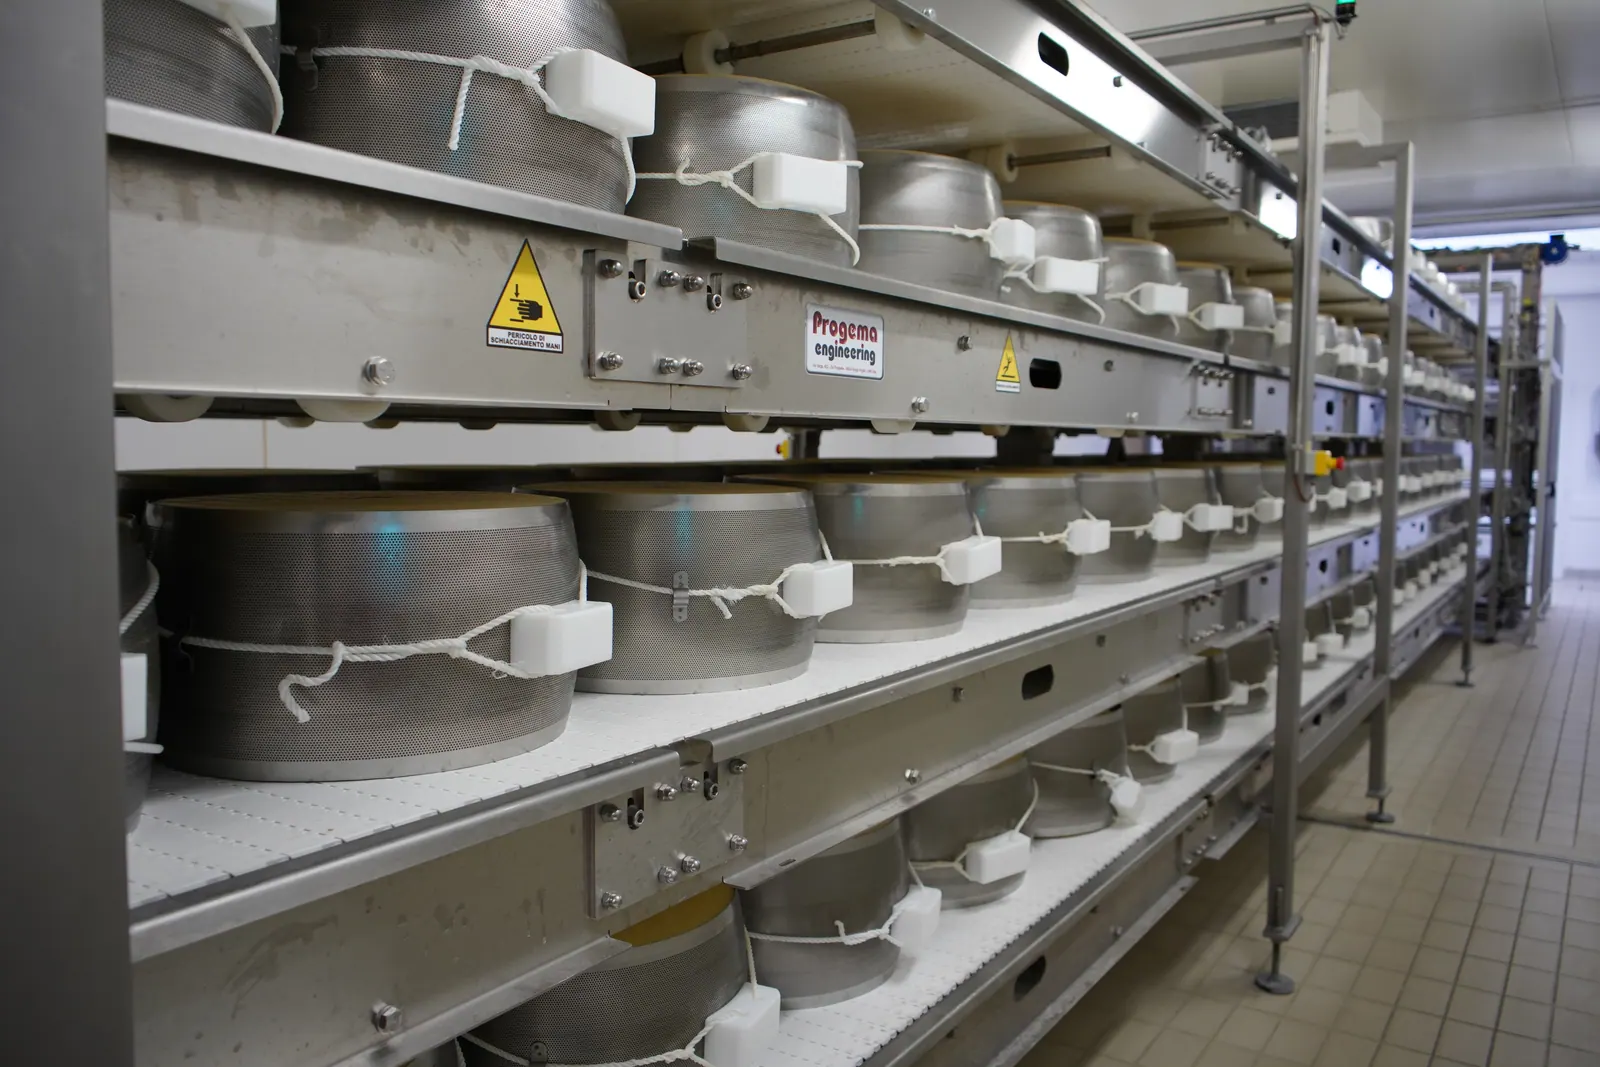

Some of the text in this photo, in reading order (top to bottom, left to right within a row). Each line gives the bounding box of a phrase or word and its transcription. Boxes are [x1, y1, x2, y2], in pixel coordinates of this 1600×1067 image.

[508, 332, 538, 340] PERICOLO
[812, 310, 878, 345] Progema
[490, 336, 561, 350] SCHIACCIAMENTO MANI
[815, 339, 876, 366] engineering
